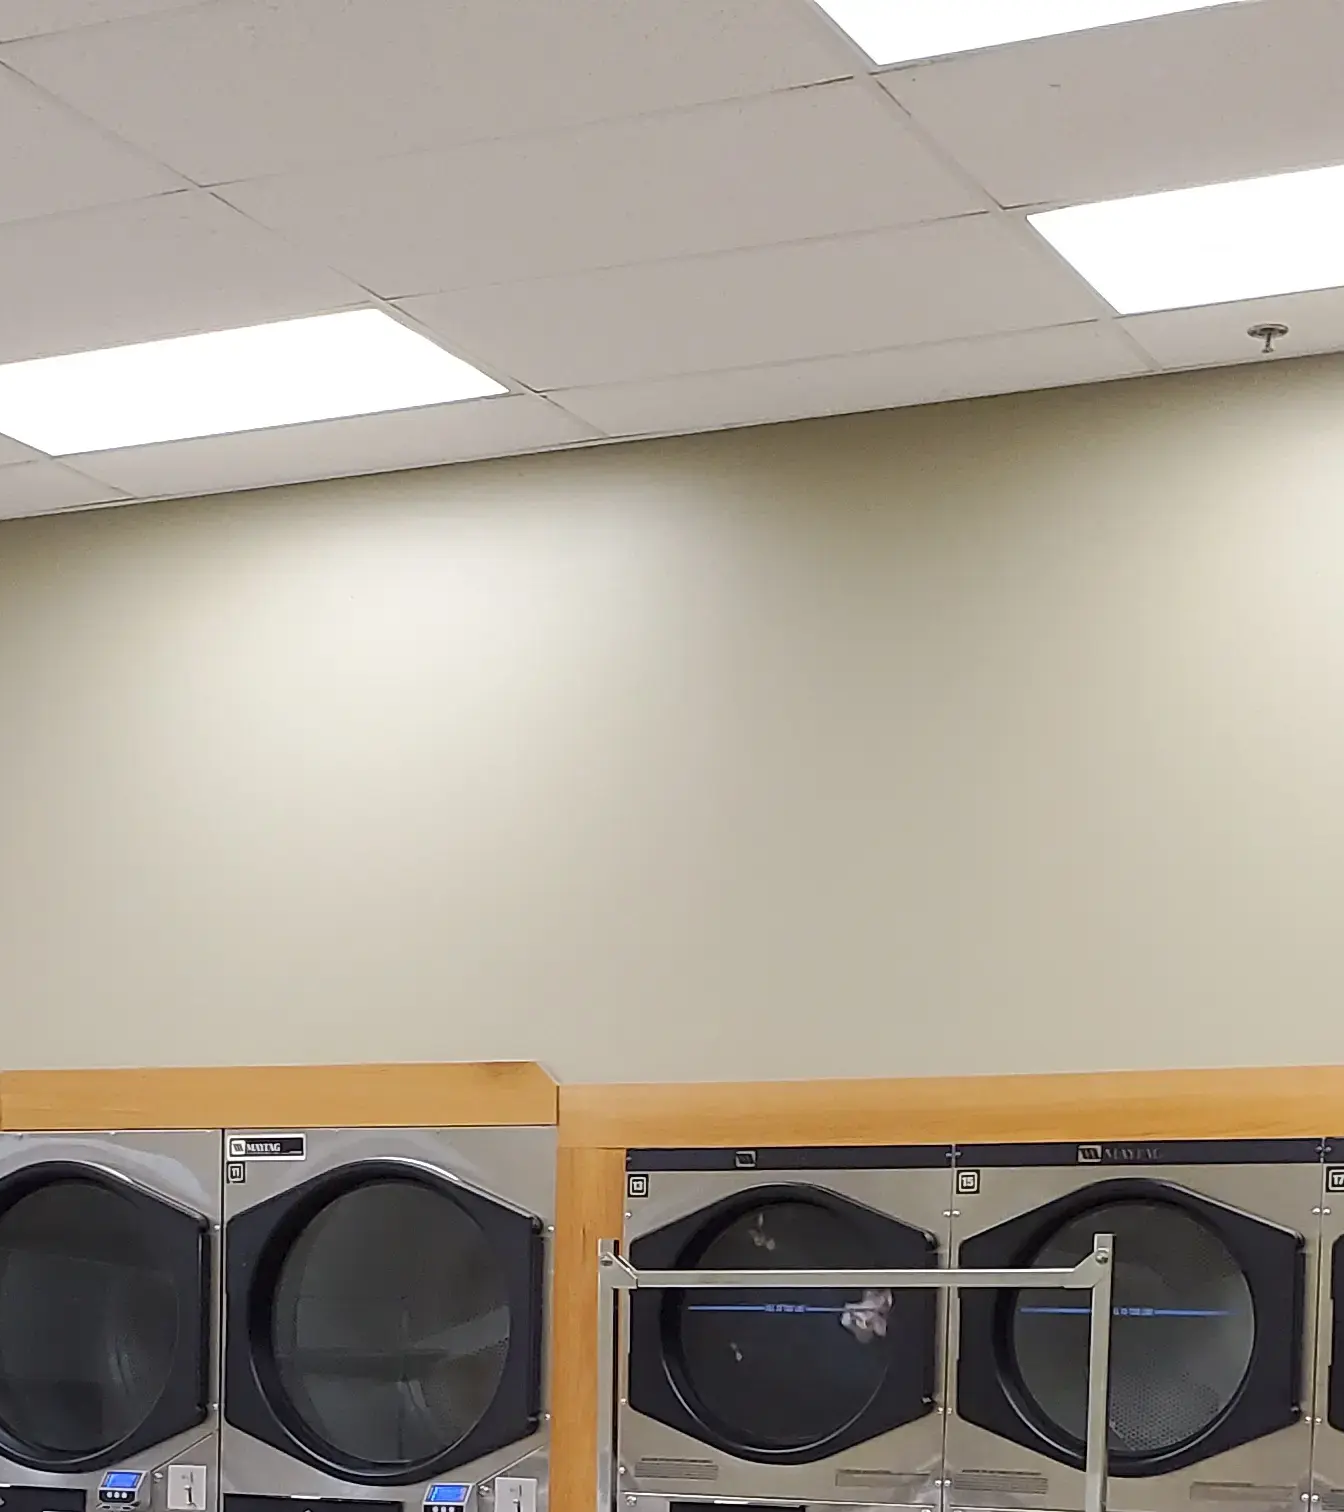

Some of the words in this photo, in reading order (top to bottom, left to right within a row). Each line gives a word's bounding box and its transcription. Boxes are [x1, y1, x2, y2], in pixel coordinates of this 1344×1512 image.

[246, 1142, 281, 1152] MAYTAG
[632, 1180, 644, 1191] 13
[961, 1176, 974, 1187] 15
